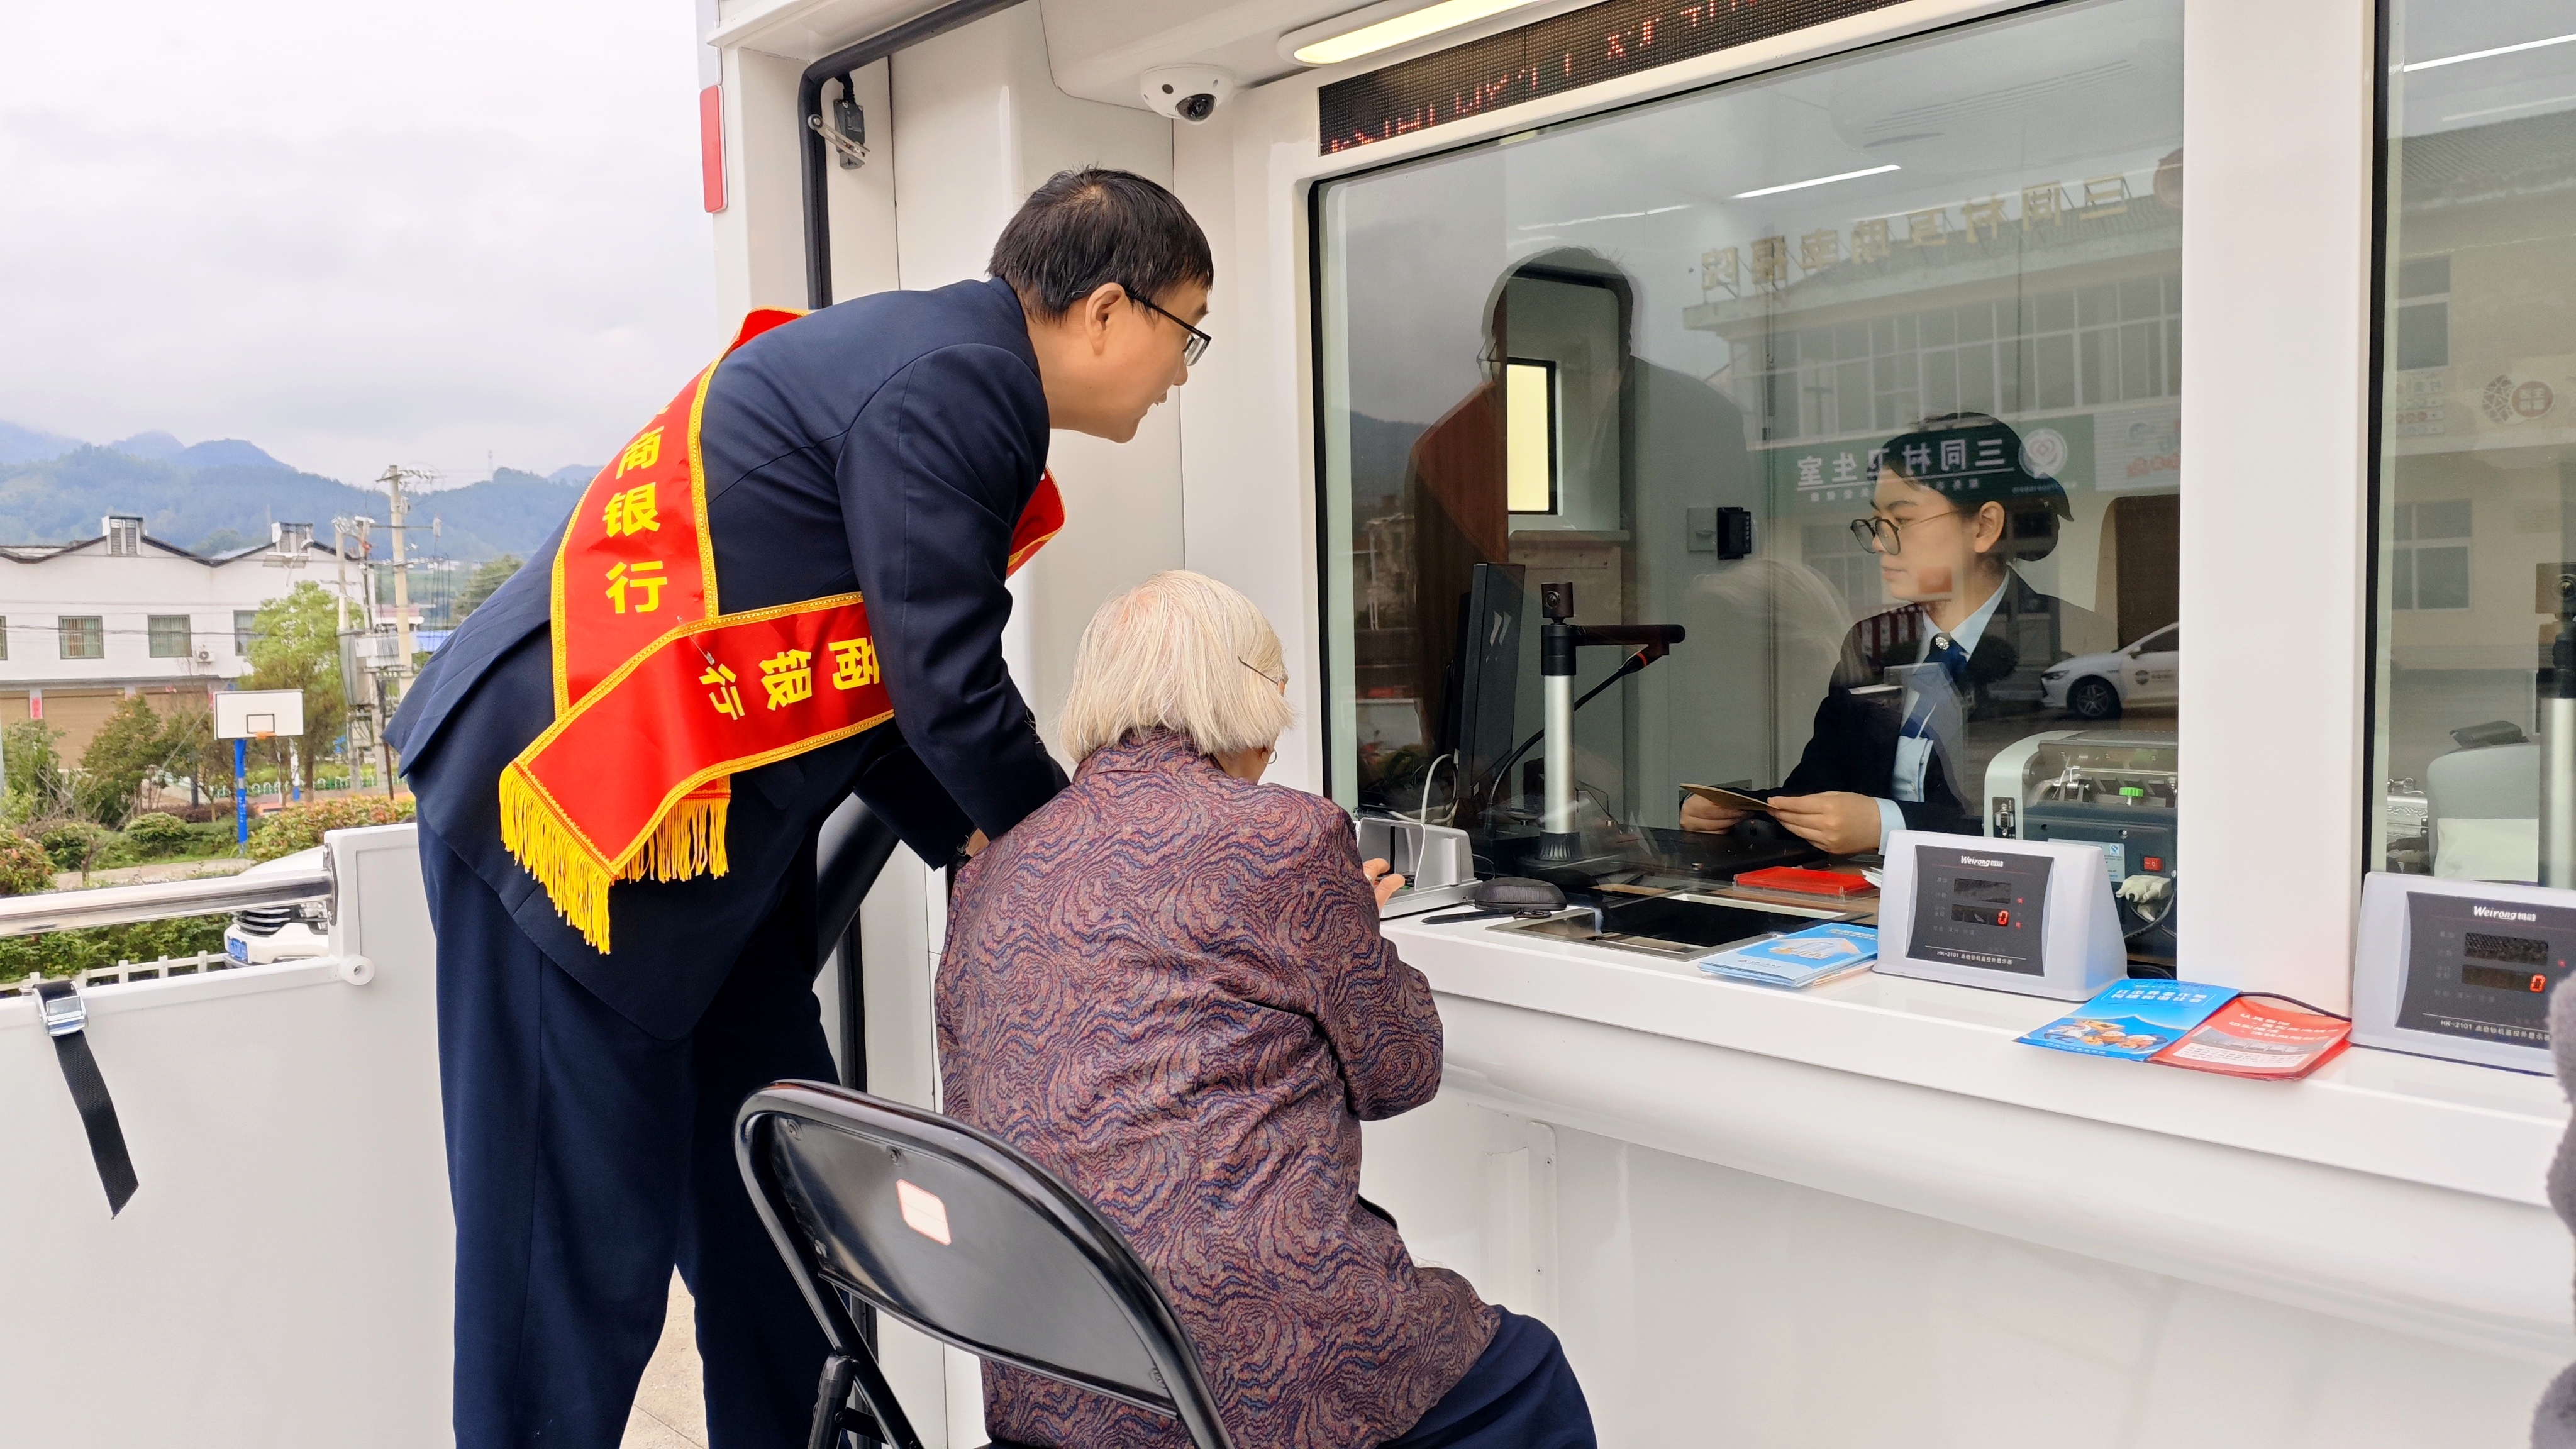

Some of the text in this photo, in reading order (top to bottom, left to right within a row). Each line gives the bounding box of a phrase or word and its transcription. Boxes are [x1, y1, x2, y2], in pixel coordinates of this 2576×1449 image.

[602, 406, 669, 614] 商银行
[1960, 855, 1990, 867] Weirong
[2473, 906, 2517, 921] Weirong
[1937, 950, 1959, 958] HK-2101
[2529, 974, 2546, 992] 0
[2440, 1020, 2472, 1030] HK-2101
